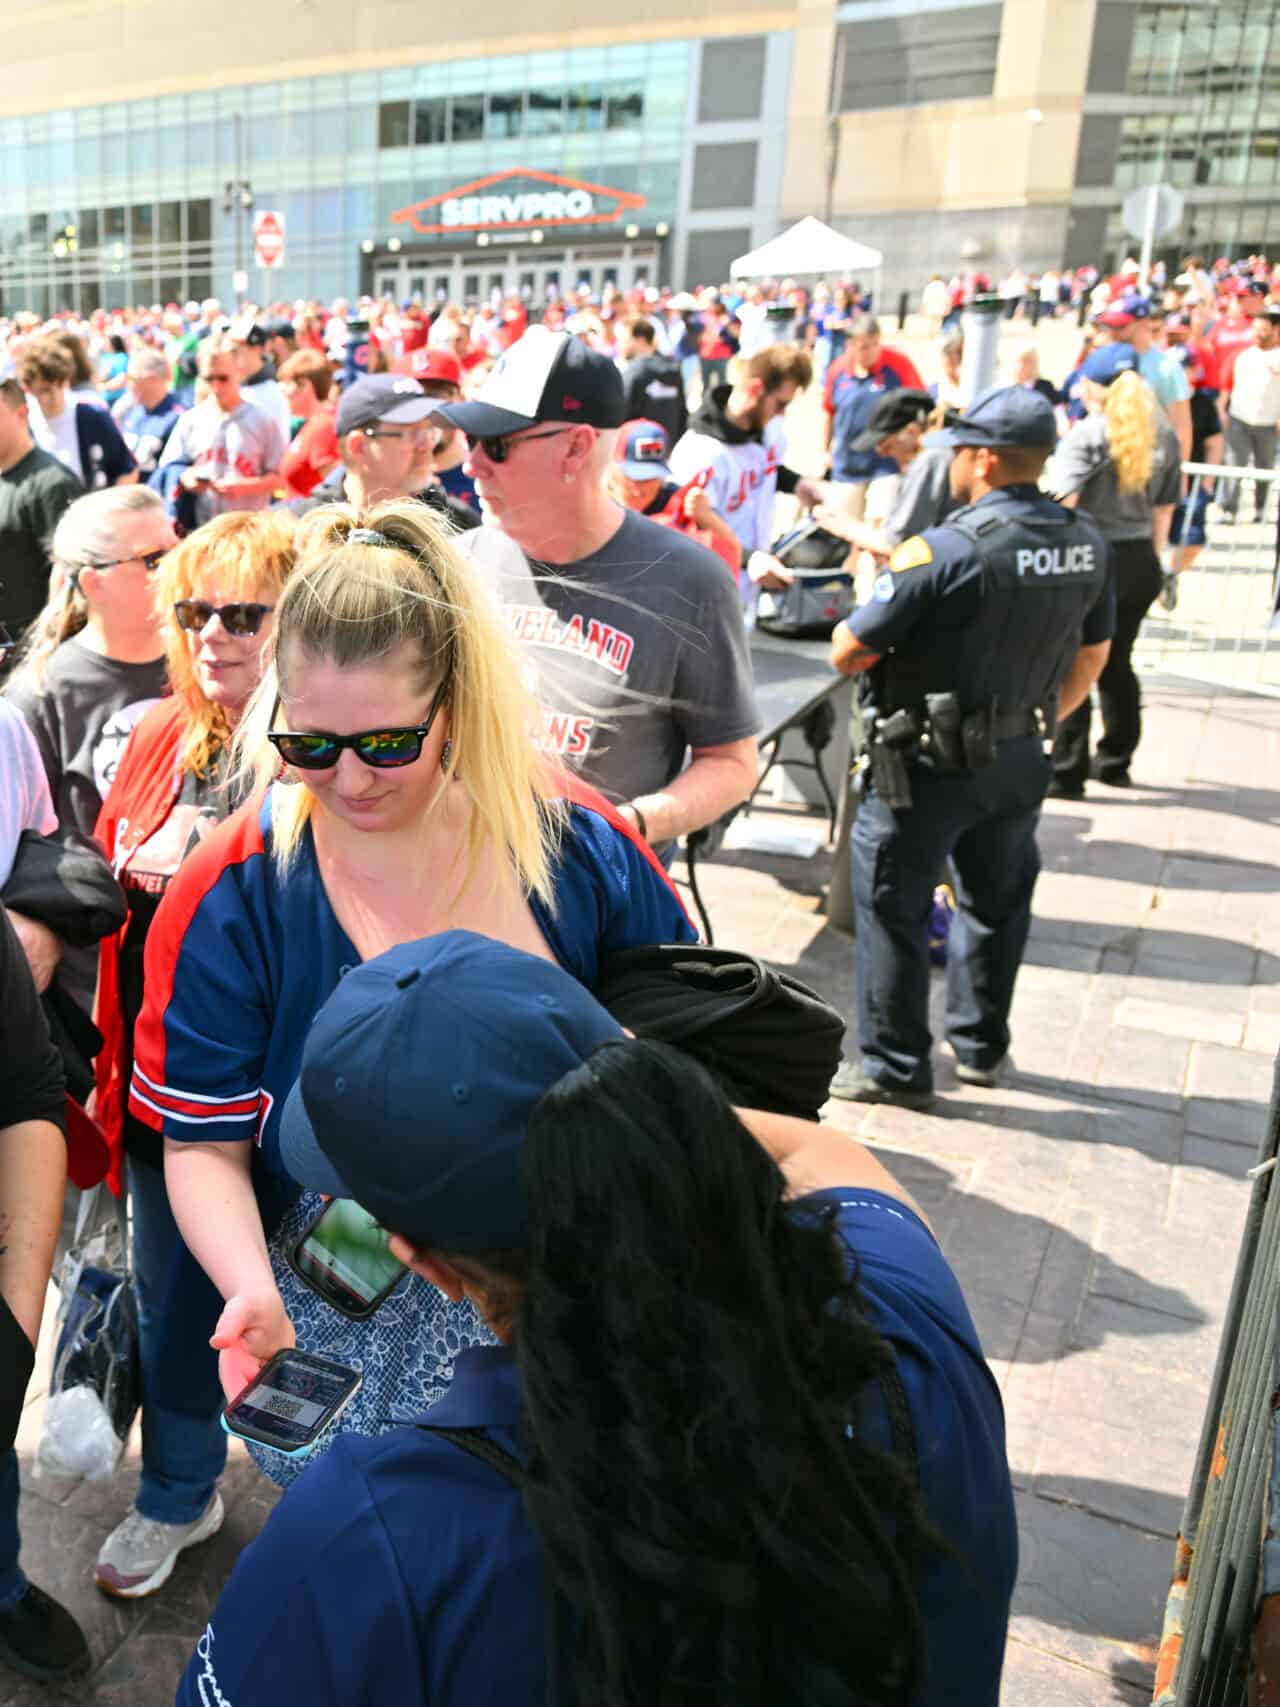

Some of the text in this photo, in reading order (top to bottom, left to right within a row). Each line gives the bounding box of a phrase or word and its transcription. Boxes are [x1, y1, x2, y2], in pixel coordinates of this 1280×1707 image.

[439, 189, 593, 227] SERVPRO
[1016, 544, 1095, 577] POLICE
[512, 606, 635, 675] ELAND
